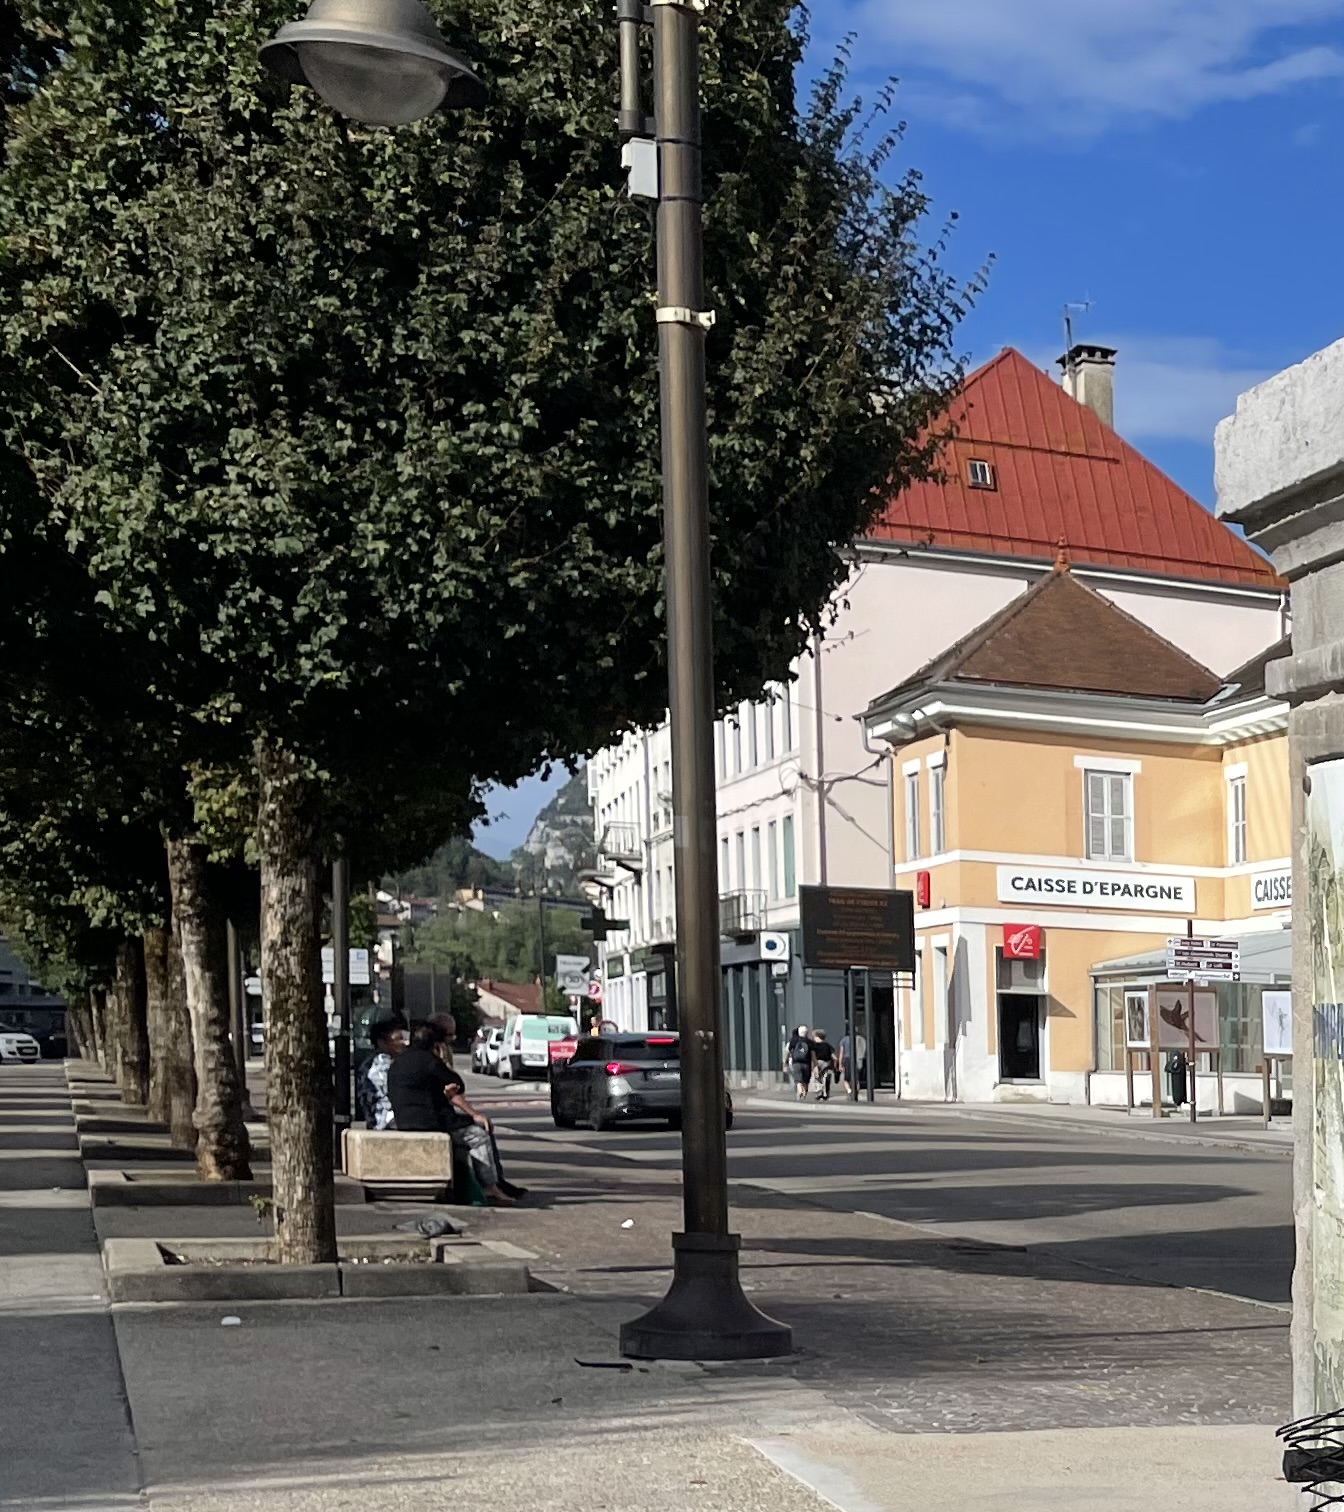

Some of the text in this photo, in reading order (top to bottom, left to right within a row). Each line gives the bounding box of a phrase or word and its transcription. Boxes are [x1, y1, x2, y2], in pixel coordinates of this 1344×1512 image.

[1011, 876, 1183, 901] CAISSE D'EPARGNE
[1254, 876, 1292, 902] CAISSE
